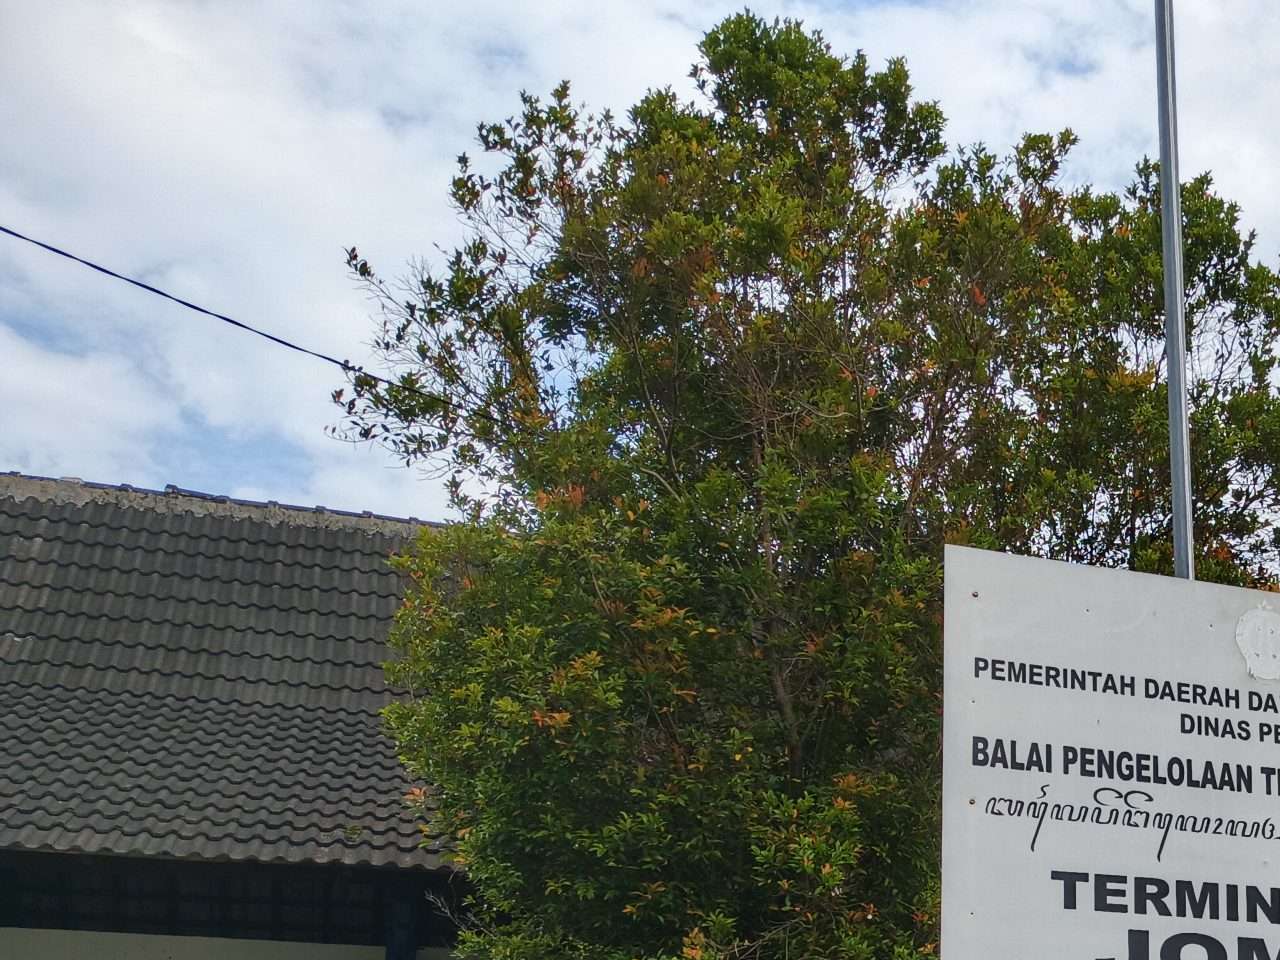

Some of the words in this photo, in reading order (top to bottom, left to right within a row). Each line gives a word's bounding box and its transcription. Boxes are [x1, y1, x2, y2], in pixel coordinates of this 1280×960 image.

[974, 656, 1136, 697] PEMERINTAH
[1144, 677, 1240, 710] DAERAH
[1180, 713, 1252, 741] DINAS
[972, 735, 1053, 774] BALAI
[1062, 745, 1253, 794] PENGELOLAAN
